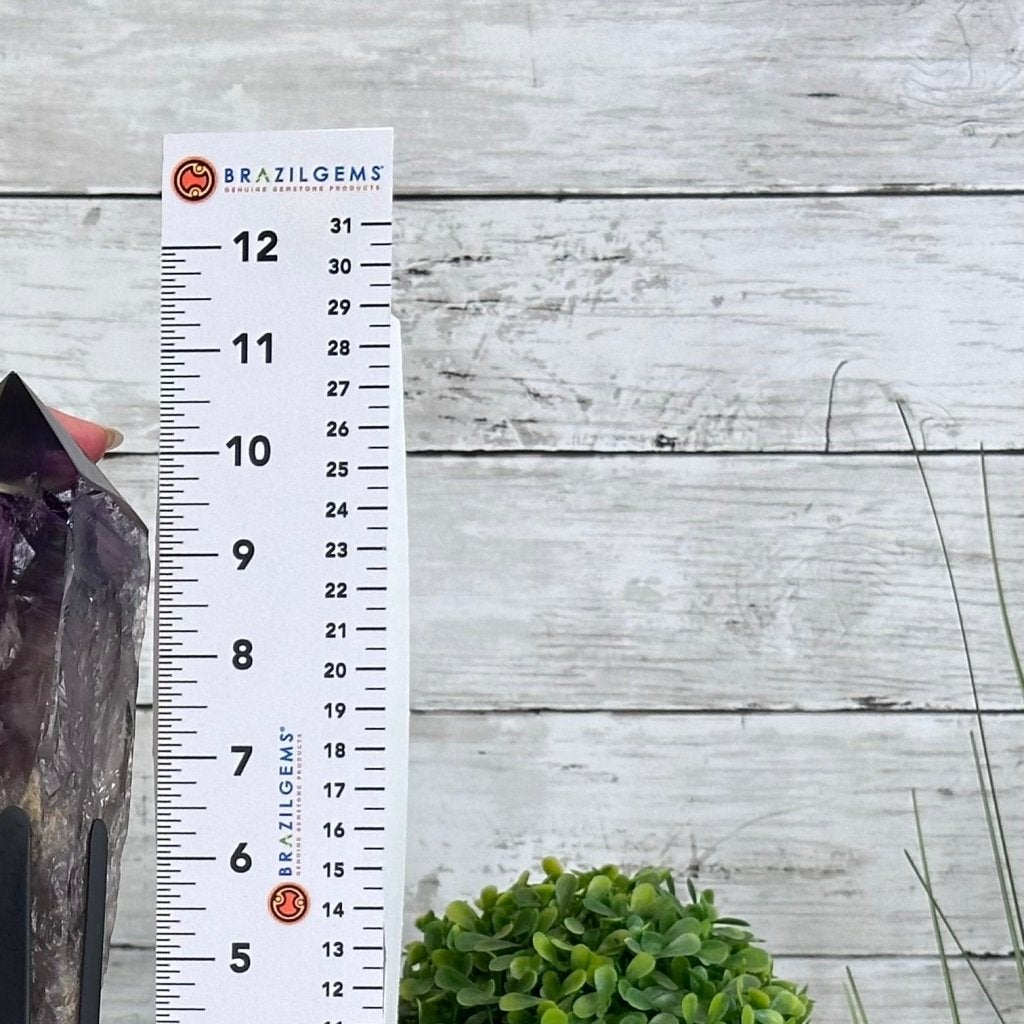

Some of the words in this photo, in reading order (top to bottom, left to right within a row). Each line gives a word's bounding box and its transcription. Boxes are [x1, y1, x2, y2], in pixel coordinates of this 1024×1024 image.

[224, 165, 384, 183] BRAZILGEMS
[331, 218, 351, 233] 31
[233, 230, 278, 262] 12
[329, 258, 351, 274] 30
[328, 299, 350, 315] 29
[233, 333, 272, 363] 11
[328, 340, 350, 356] 28
[327, 381, 350, 396] 27
[327, 421, 349, 437] 26
[226, 435, 271, 466] 10
[326, 462, 348, 477] 25
[326, 502, 348, 518] 24
[233, 539, 254, 570] 9
[325, 542, 347, 558] 23
[325, 583, 347, 598] 22
[326, 623, 345, 638] 21
[232, 639, 253, 670] 8
[324, 663, 346, 678] 20
[324, 703, 346, 718] 19
[324, 743, 345, 758] 18
[231, 746, 252, 776] 7
[324, 783, 345, 798] 17
[279, 727, 294, 876] BRAZILGEMS
[323, 822, 344, 837] 16
[230, 843, 252, 873] 6
[323, 862, 344, 877] 15
[323, 902, 344, 917] 14
[323, 942, 344, 957] 13
[230, 943, 250, 973] 5
[322, 982, 344, 997] 12
